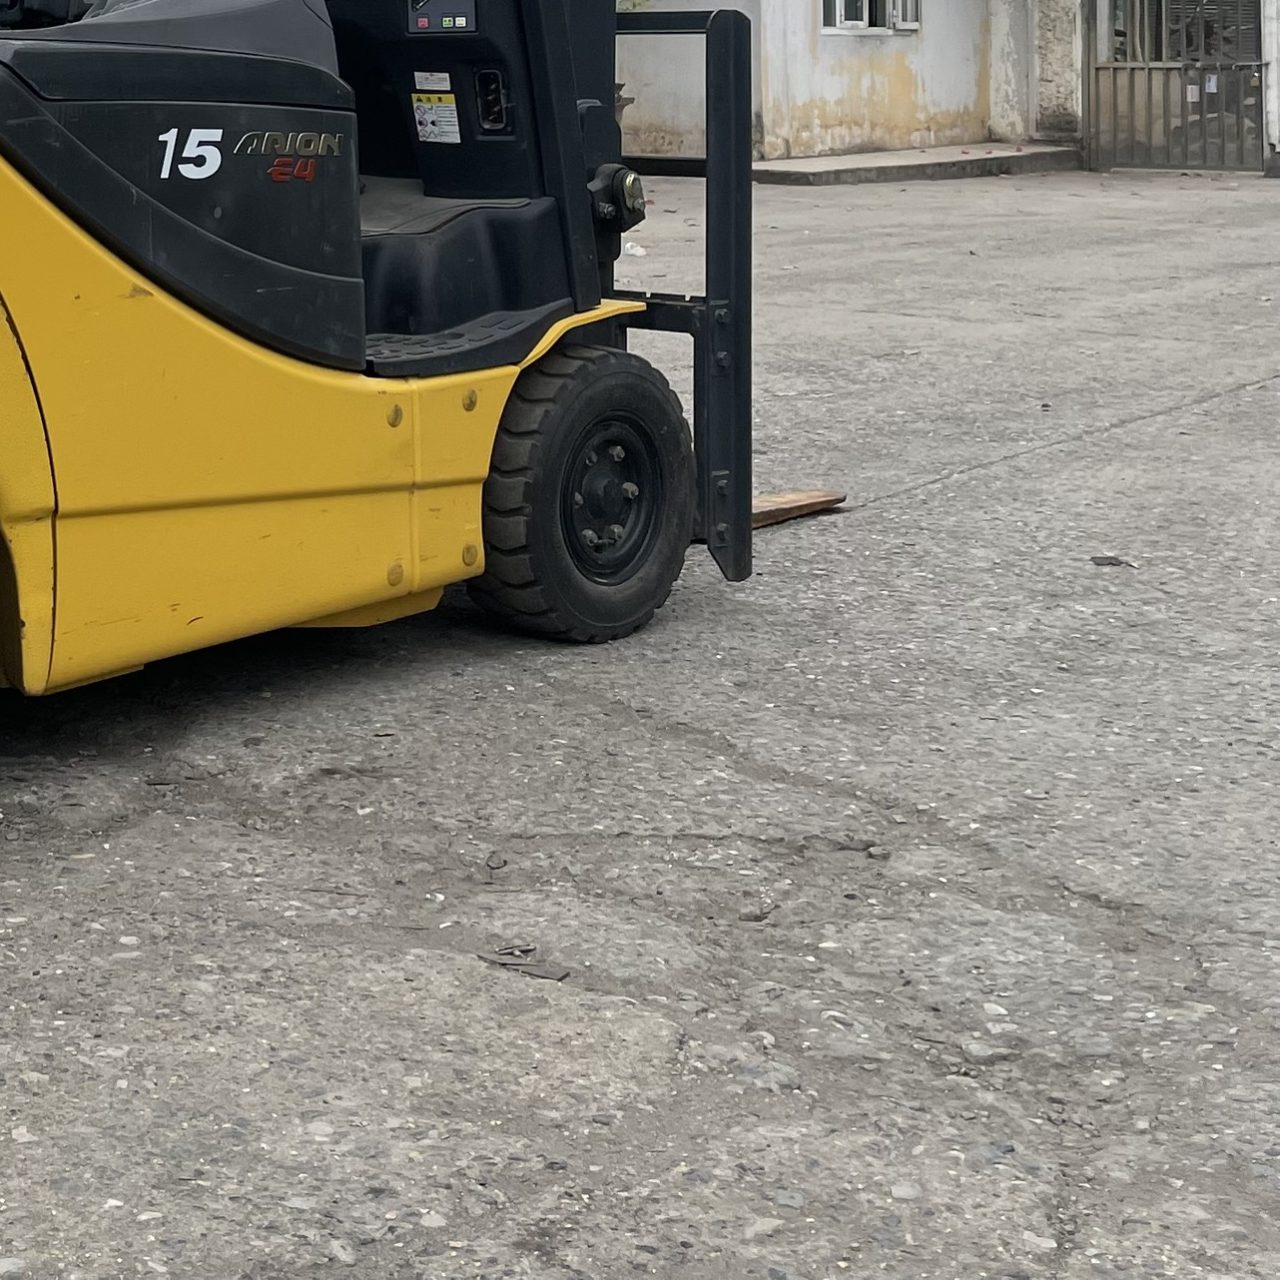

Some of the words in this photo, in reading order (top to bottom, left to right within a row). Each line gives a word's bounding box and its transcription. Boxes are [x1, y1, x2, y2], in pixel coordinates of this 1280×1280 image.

[158, 127, 224, 180] 15
[233, 131, 345, 157] ARION
[267, 157, 318, 182] E4
